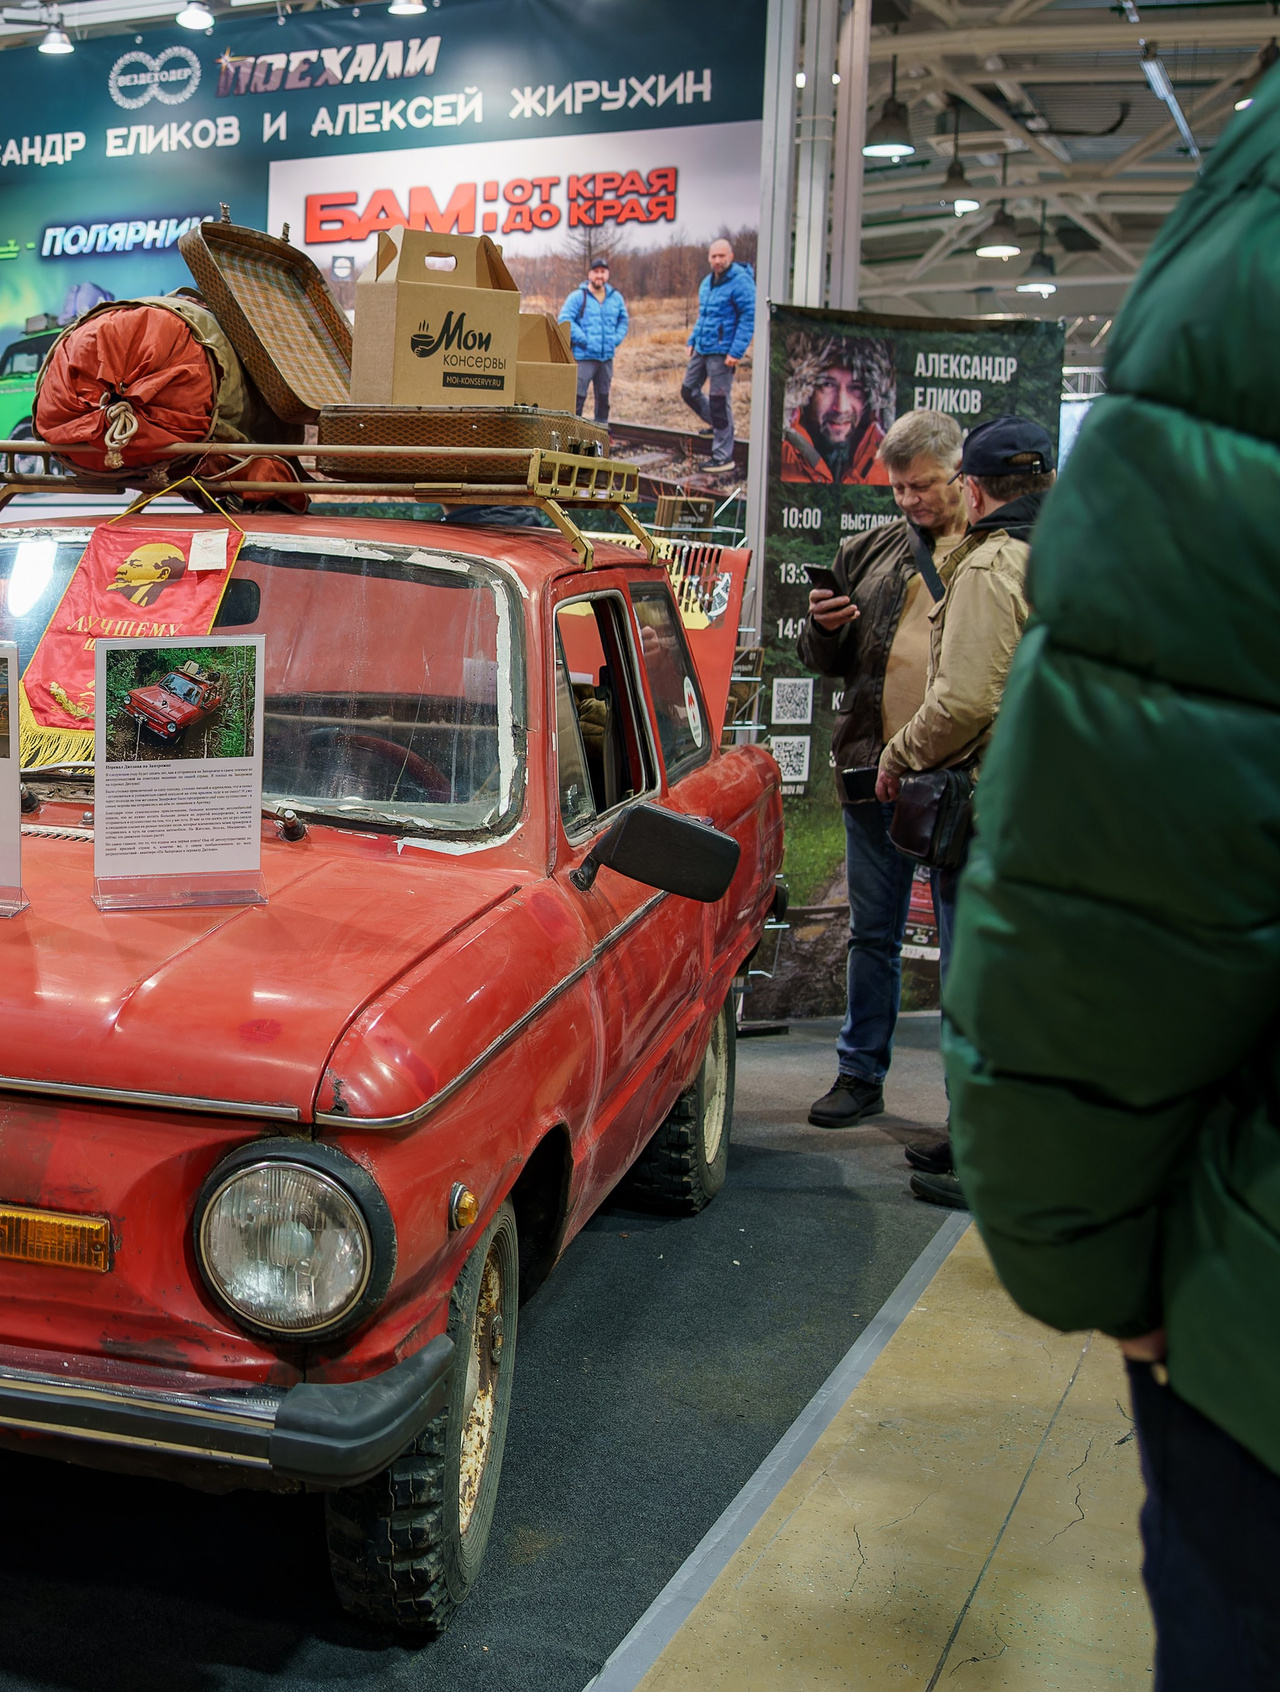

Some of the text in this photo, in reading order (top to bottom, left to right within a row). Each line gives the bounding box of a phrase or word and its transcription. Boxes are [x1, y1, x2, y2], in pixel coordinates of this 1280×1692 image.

[216, 36, 442, 97] ПОЕХАЛИ
[105, 115, 240, 158] ЕЛИКОВ
[263, 111, 287, 143] И
[310, 87, 483, 138] АЛЕКСЕЙ
[509, 69, 712, 120] ЖИРУХИН
[502, 167, 678, 205] ОТ КРАЯ
[501, 194, 677, 234] ДО КРАЯ
[436, 310, 492, 352] Мои
[443, 353, 506, 372] консервы
[914, 353, 1018, 384] АЛЕКСАНДР
[446, 375, 502, 388] MOI-KONSERVY.RU
[914, 386, 982, 414] ЕЛИКОВ
[781, 507, 821, 529] 10:00
[66, 615, 184, 637] ЛУЧШЕМУ
[776, 618, 806, 639] 14:0
